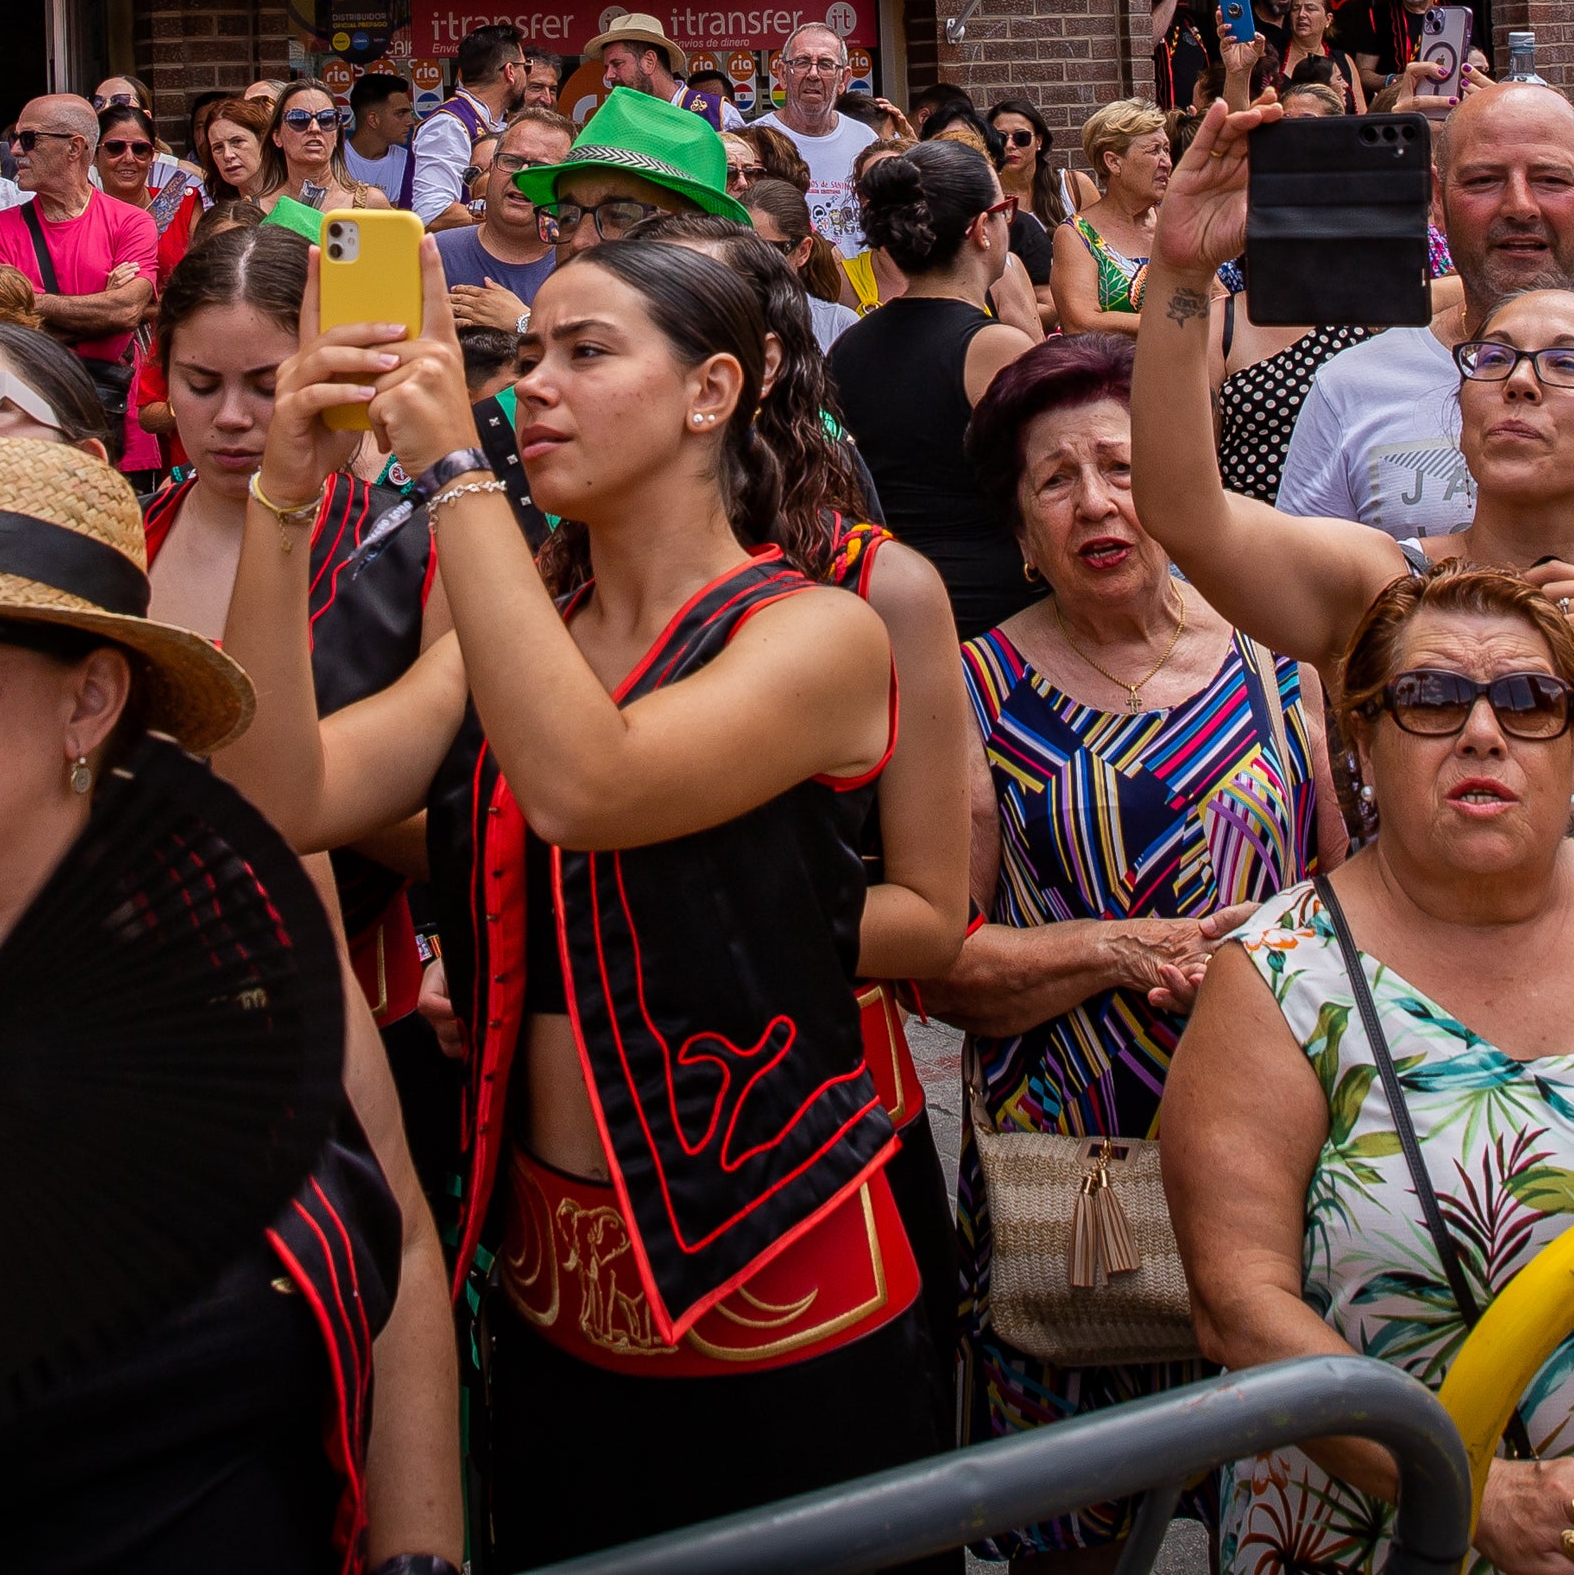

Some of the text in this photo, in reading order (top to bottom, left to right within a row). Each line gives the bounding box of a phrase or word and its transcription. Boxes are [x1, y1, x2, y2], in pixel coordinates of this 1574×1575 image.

[332, 13, 387, 22] DISTRIBUIDOR
[670, 8, 804, 36] i-transfer
[706, 38, 719, 48] de
[721, 37, 750, 47] dinero
[692, 56, 716, 71] ria
[731, 54, 753, 71] ria
[849, 52, 869, 68] ria
[326, 65, 350, 82] ria
[416, 62, 439, 79] ria
